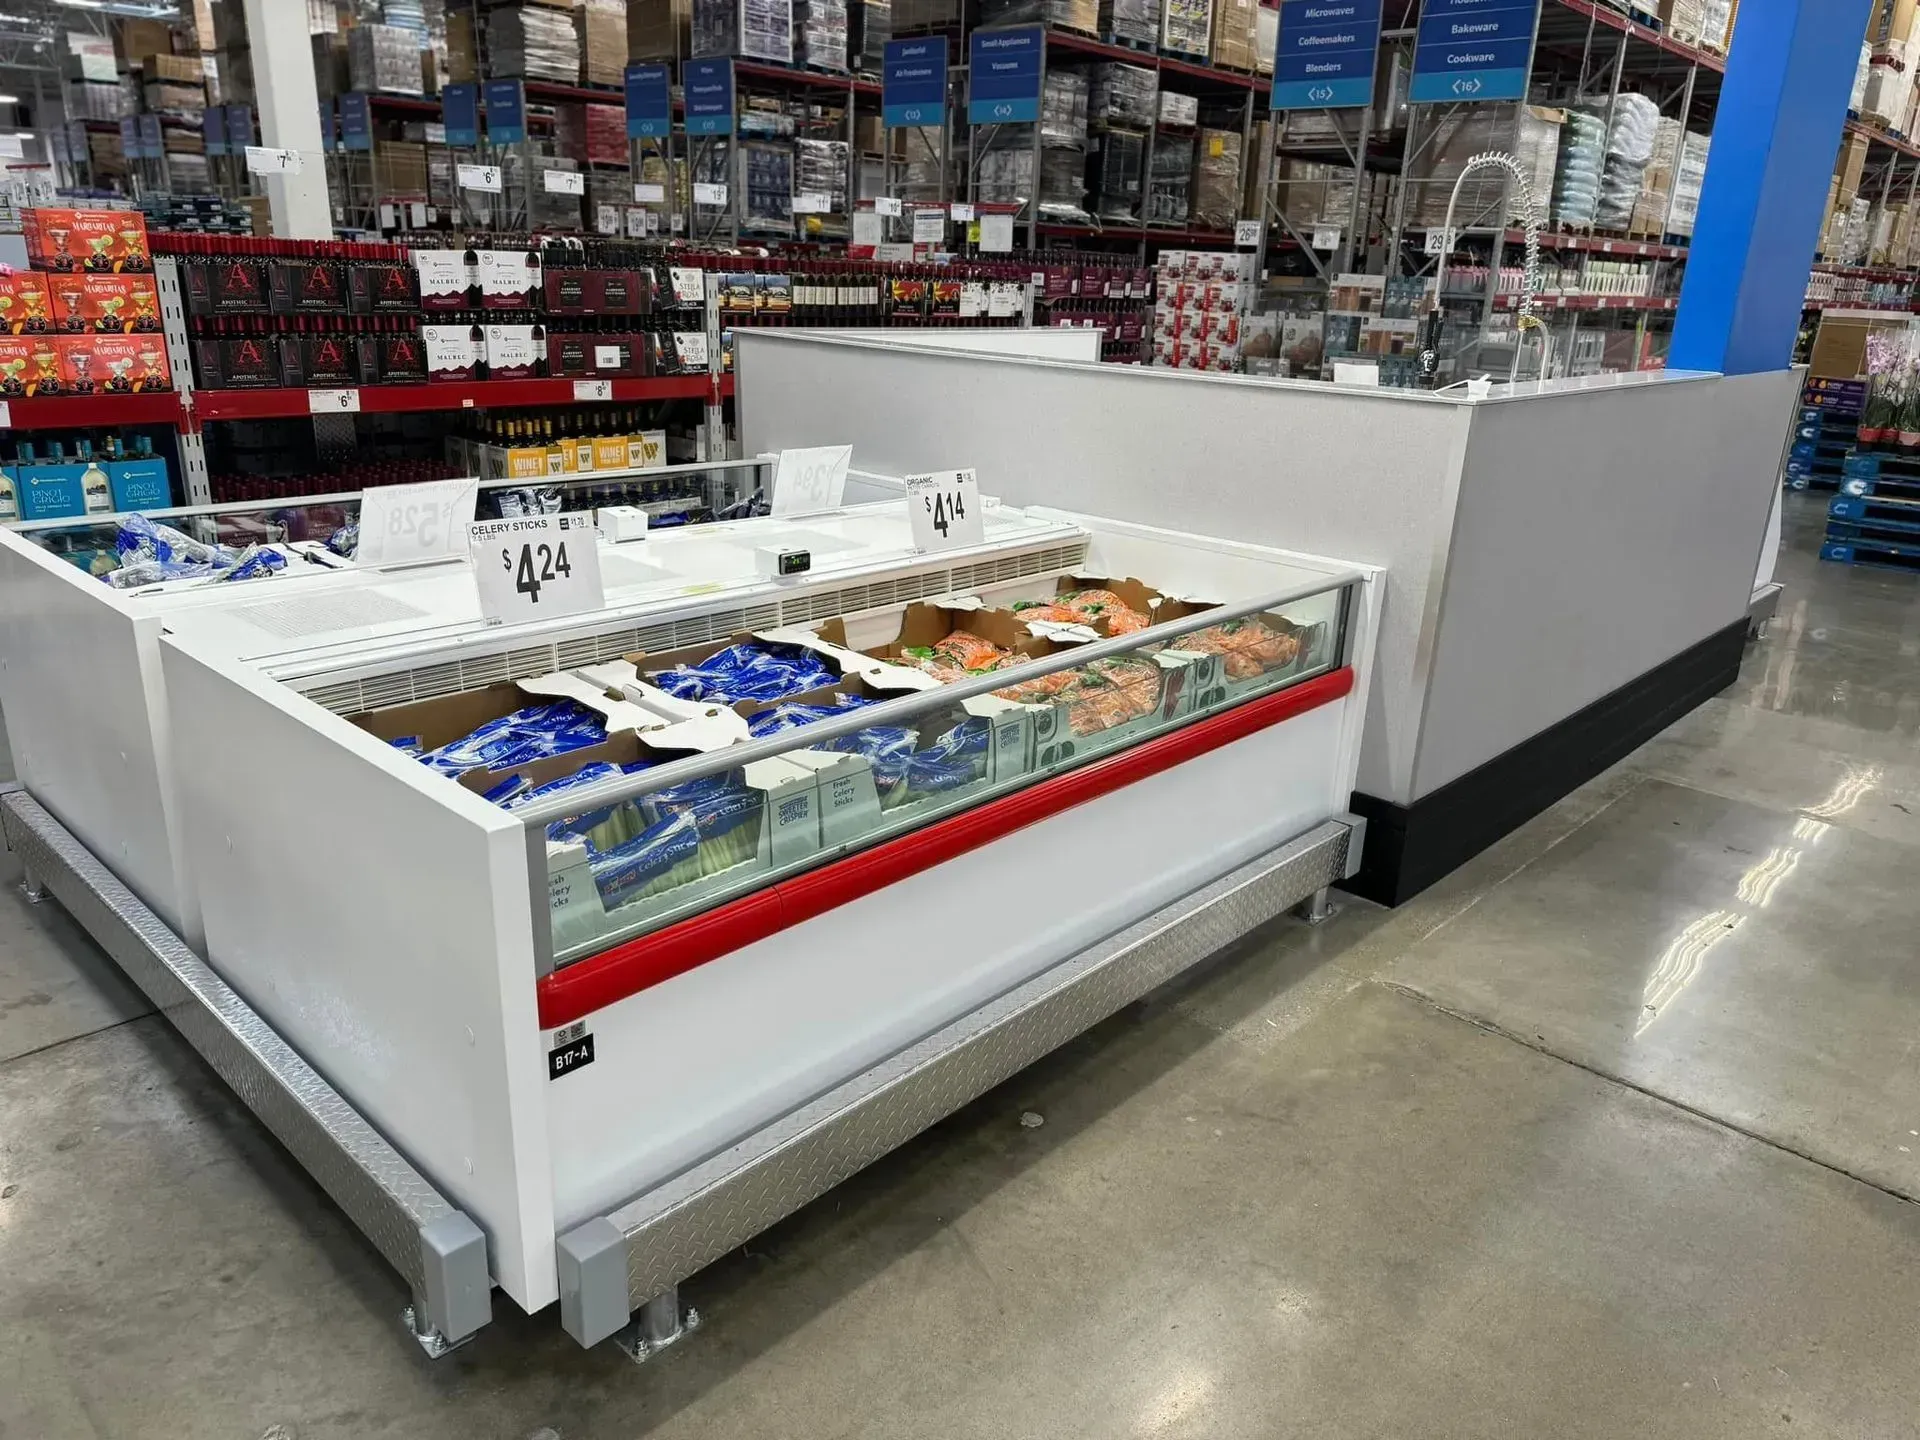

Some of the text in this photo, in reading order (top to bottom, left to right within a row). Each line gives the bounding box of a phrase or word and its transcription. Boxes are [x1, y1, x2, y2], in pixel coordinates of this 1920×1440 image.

[1305, 7, 1355, 18] Microwaves
[1451, 23, 1499, 34] Bakeware
[1298, 34, 1355, 46] Coffeemakers
[1447, 53, 1495, 64] Cookware
[1305, 62, 1342, 73] Blenders
[1461, 81, 1473, 92] 16
[1316, 89, 1326, 98] 15
[72, 222, 116, 233] MARGARITAS
[84, 284, 127, 295] MARGARITAS
[92, 345, 136, 356] MARGARITAS
[127, 480, 155, 492] PINOT
[906, 476, 933, 486] ORGANIC
[32, 489, 63, 498] PINOT
[126, 488, 160, 498] GRIGIO
[32, 495, 71, 505] GRIGIO
[925, 491, 965, 538] $414
[471, 523, 509, 536] CELERY
[512, 519, 548, 531] STICKS
[502, 541, 571, 604] $424
[832, 778, 851, 789] Fresh
[833, 787, 855, 798] Celery
[834, 797, 854, 808] Sticks
[778, 801, 808, 819] SWEETER
[779, 810, 809, 826] CRISPIER
[555, 1045, 588, 1070] B17-A
